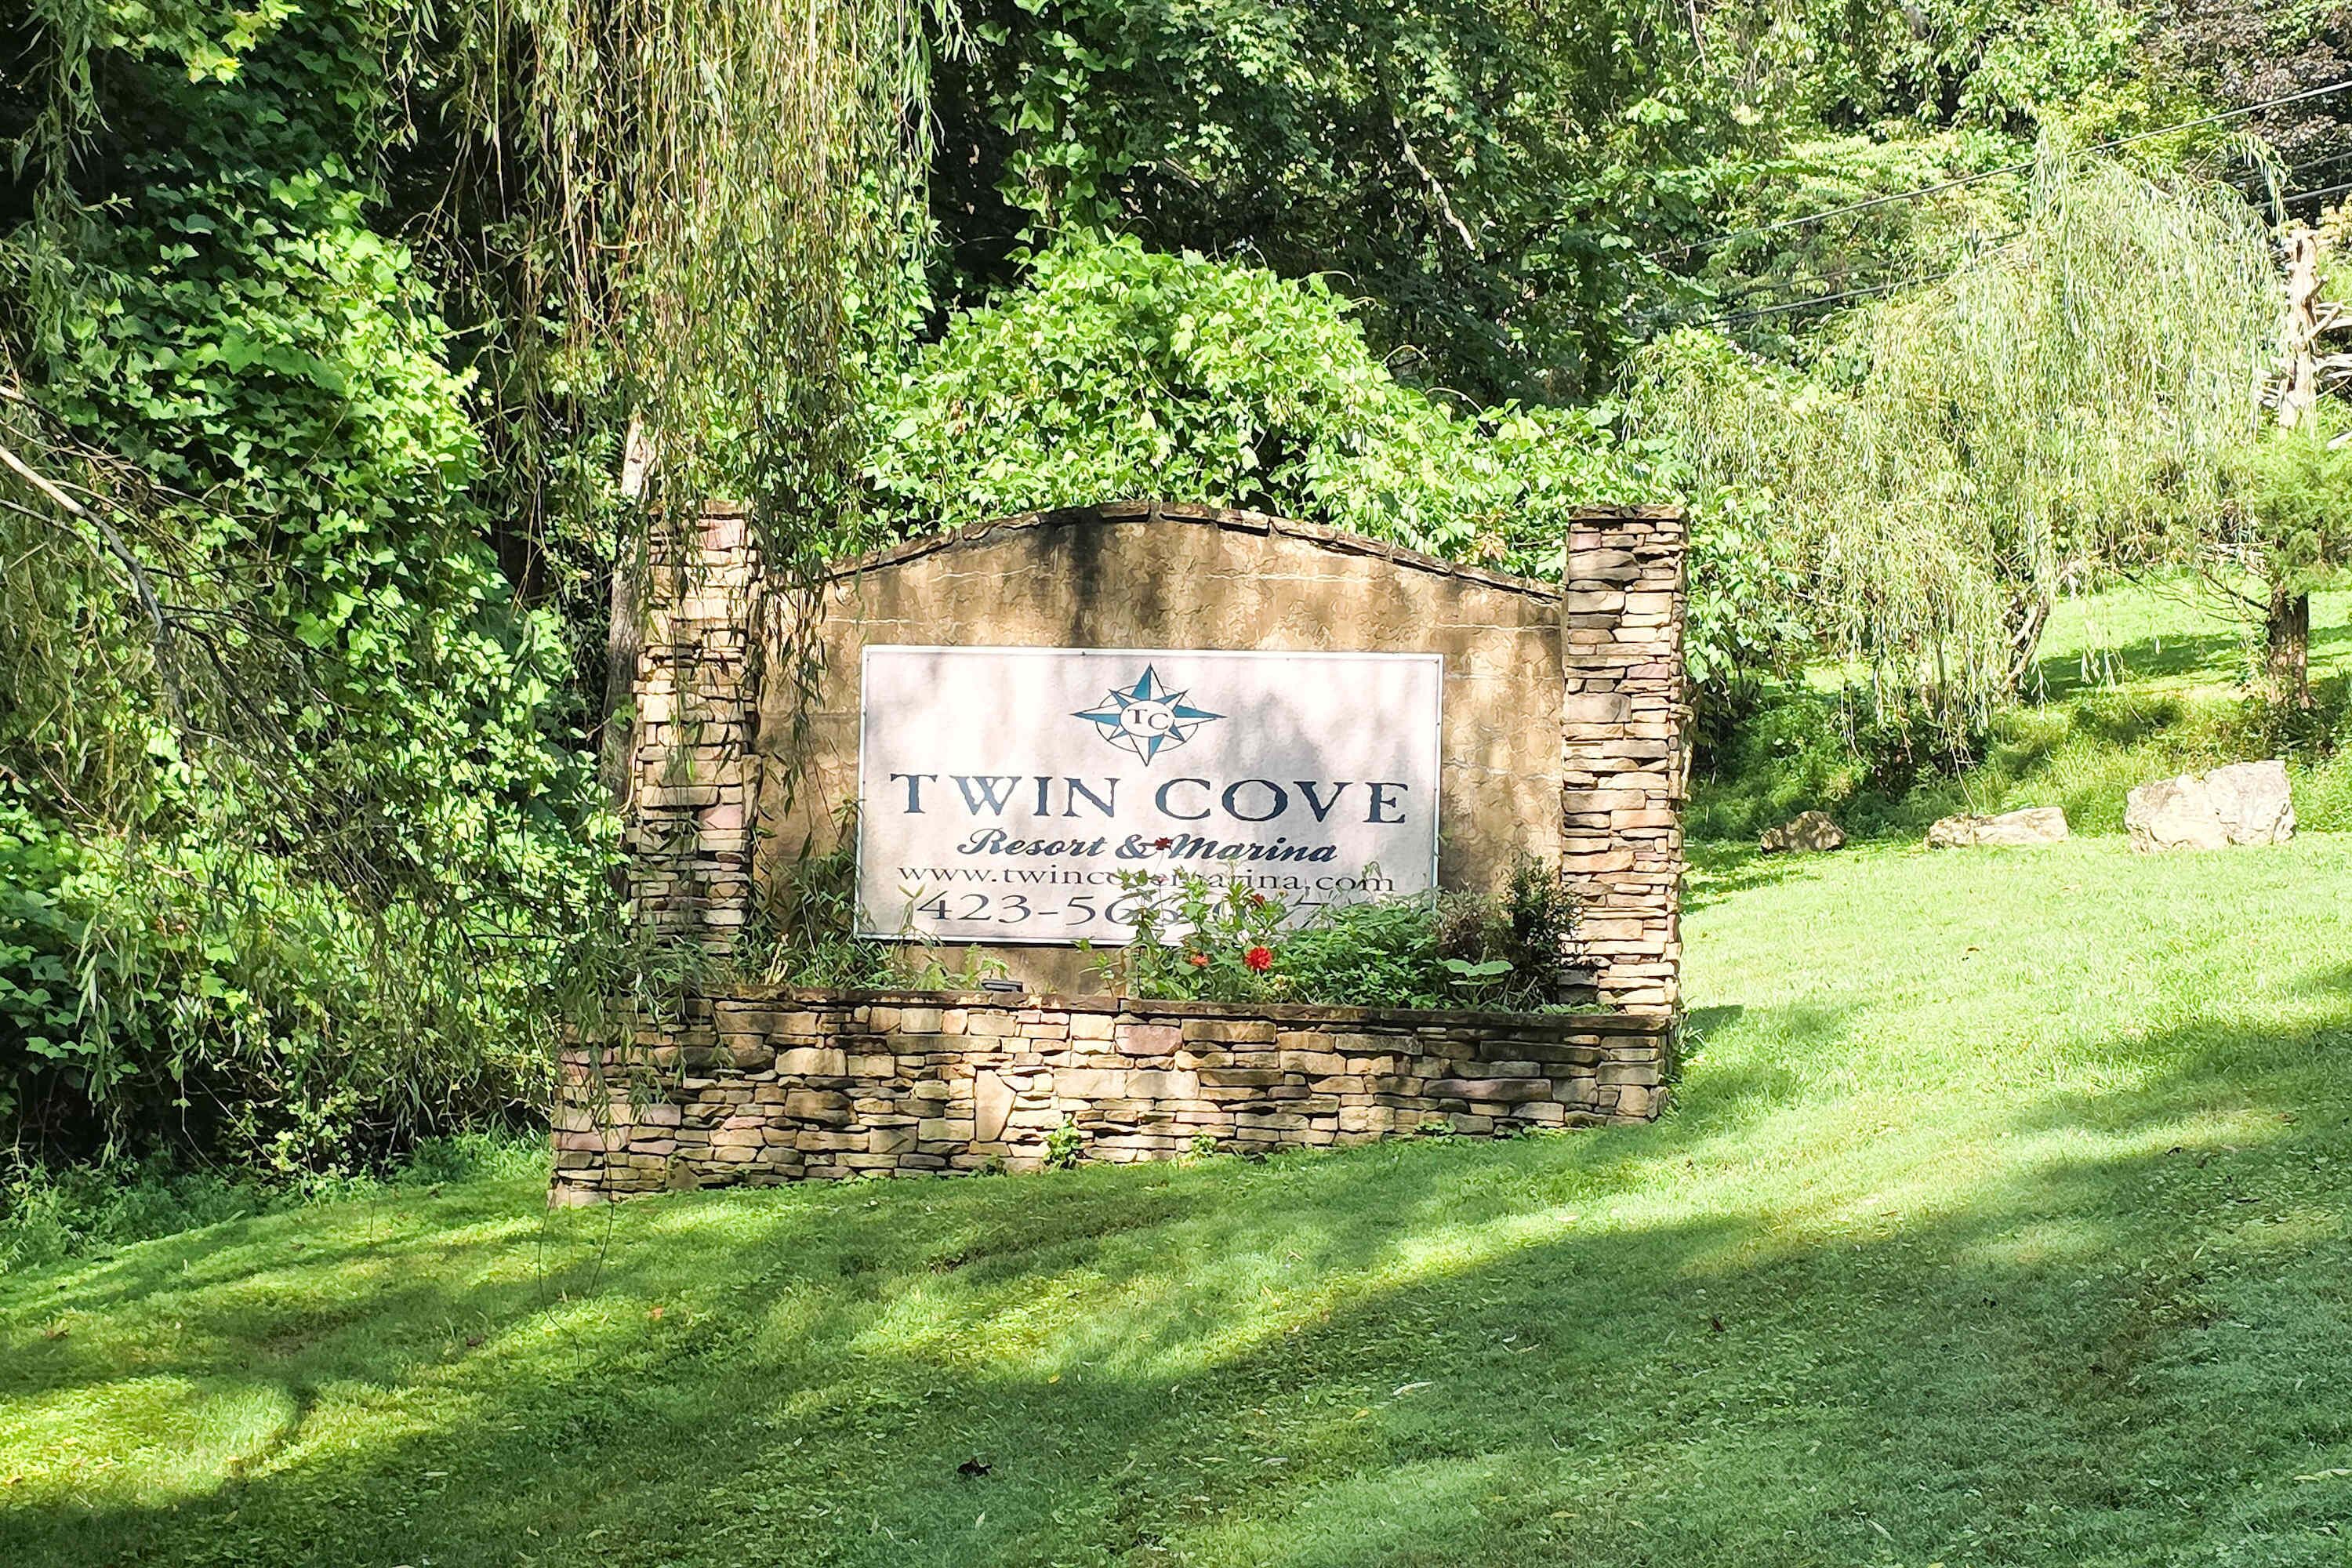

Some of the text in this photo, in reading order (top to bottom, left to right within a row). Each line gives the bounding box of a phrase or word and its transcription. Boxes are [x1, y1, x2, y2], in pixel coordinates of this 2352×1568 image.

[1127, 709, 1169, 731] TC
[890, 773, 1409, 823] TWIN COVE
[956, 826, 1338, 862] Resort & Marina
